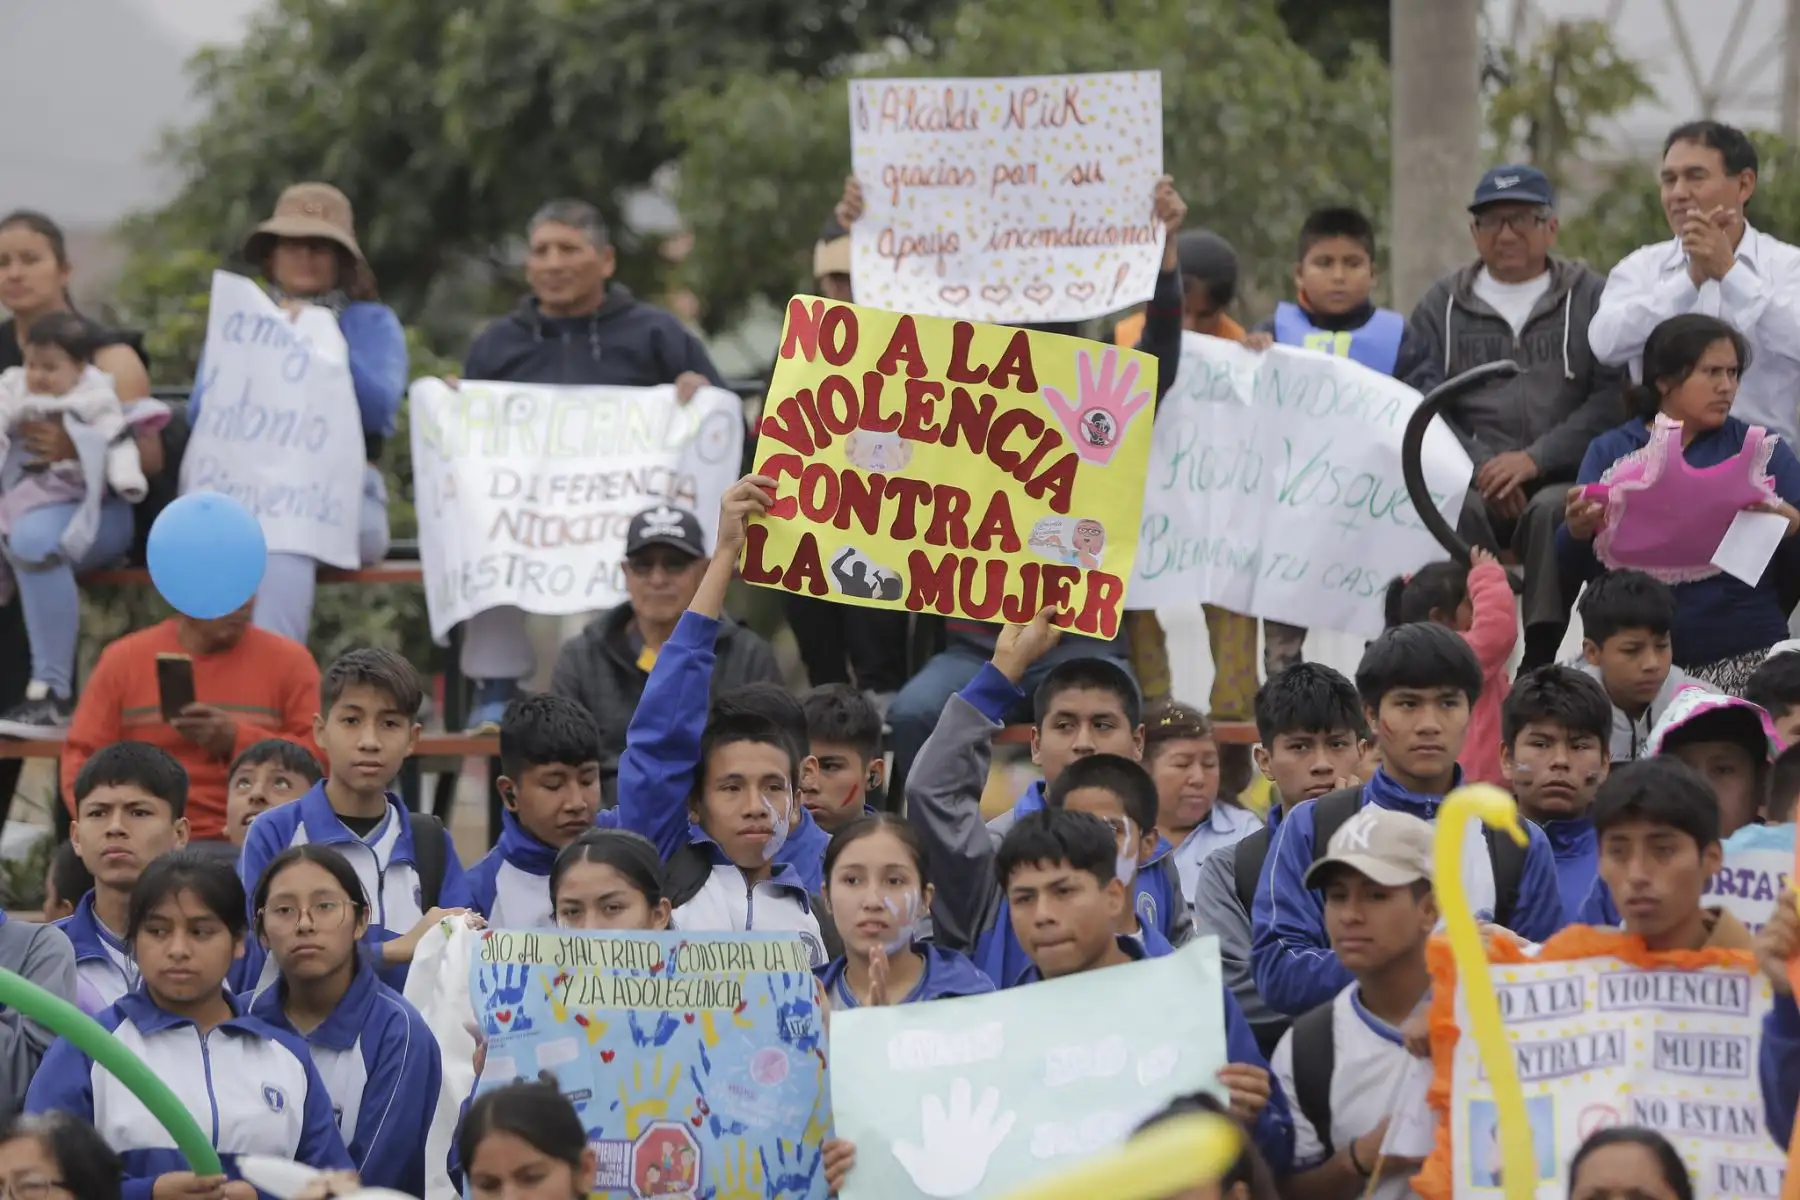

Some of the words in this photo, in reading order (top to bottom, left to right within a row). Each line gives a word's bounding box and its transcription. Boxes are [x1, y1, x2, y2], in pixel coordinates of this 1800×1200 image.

[780, 298, 859, 367] NO
[876, 315, 928, 378] A
[946, 321, 1039, 393] LA
[762, 371, 1080, 514] VIOLENCIA
[756, 453, 1021, 553] CONTRA
[741, 524, 829, 596] LA
[907, 549, 1125, 638] MUJER
[554, 937, 662, 970] MALTRATO
[678, 941, 756, 973] CONTRA
[764, 942, 786, 971] LA
[578, 975, 606, 1005] LA
[1605, 974, 1742, 1008] VIOLENCIA
[1660, 1036, 1743, 1070] MUJER
[1634, 1098, 1667, 1126] NO
